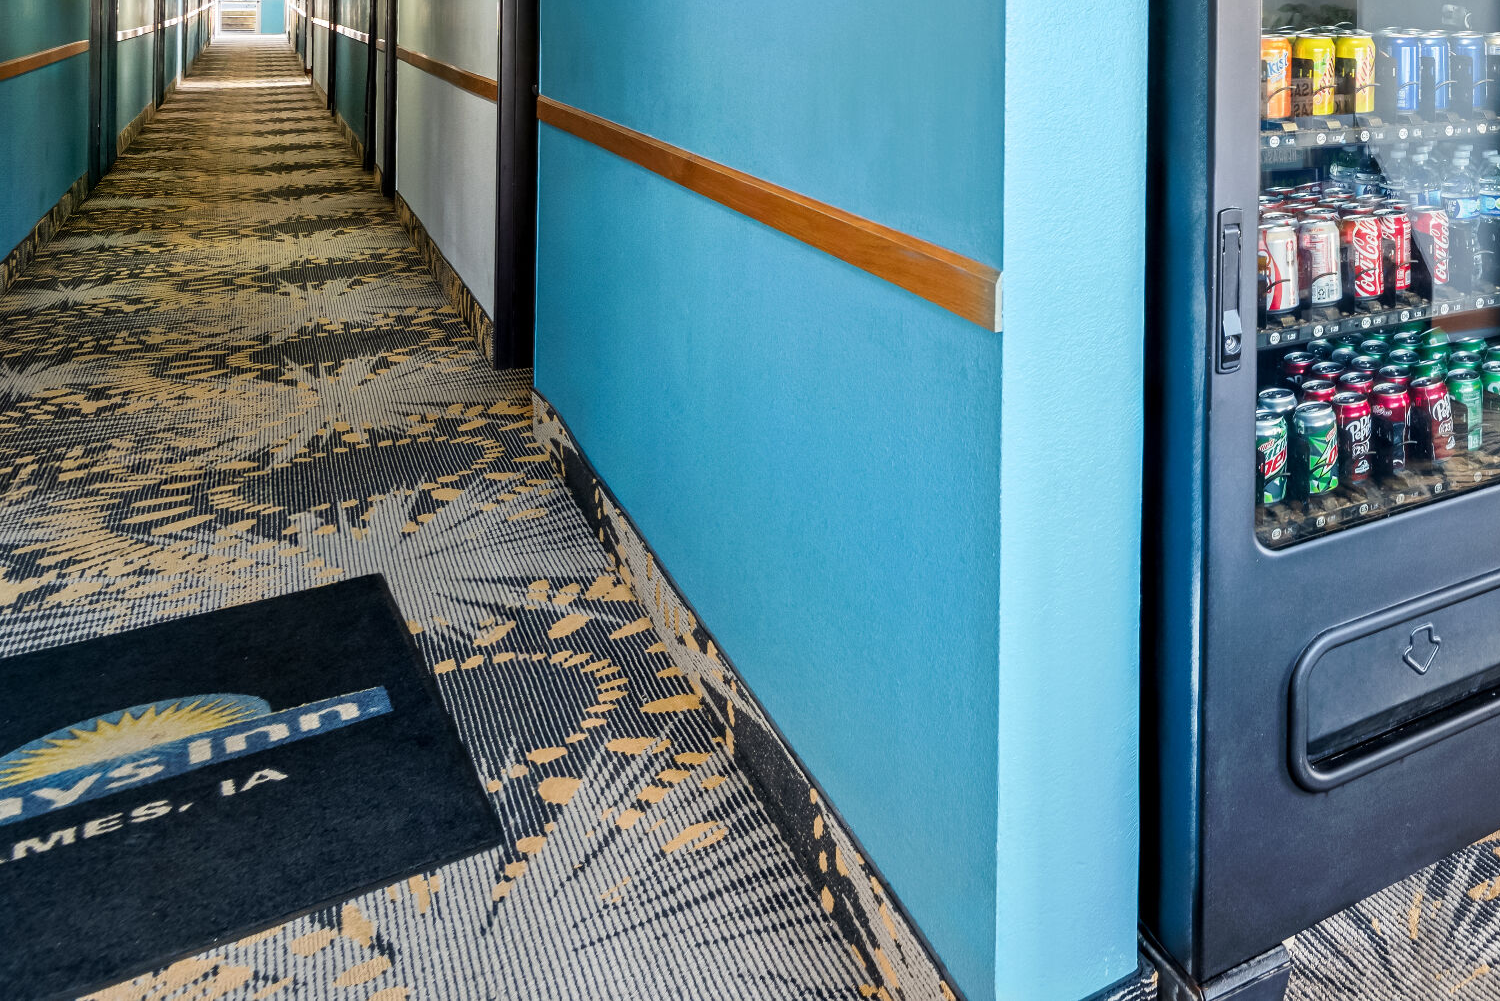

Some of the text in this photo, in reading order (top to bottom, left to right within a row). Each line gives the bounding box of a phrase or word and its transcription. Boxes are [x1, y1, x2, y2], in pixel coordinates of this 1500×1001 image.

[1266, 49, 1288, 77] kist
[187, 702, 361, 765] Inn
[0, 768, 288, 864] MES, IA
